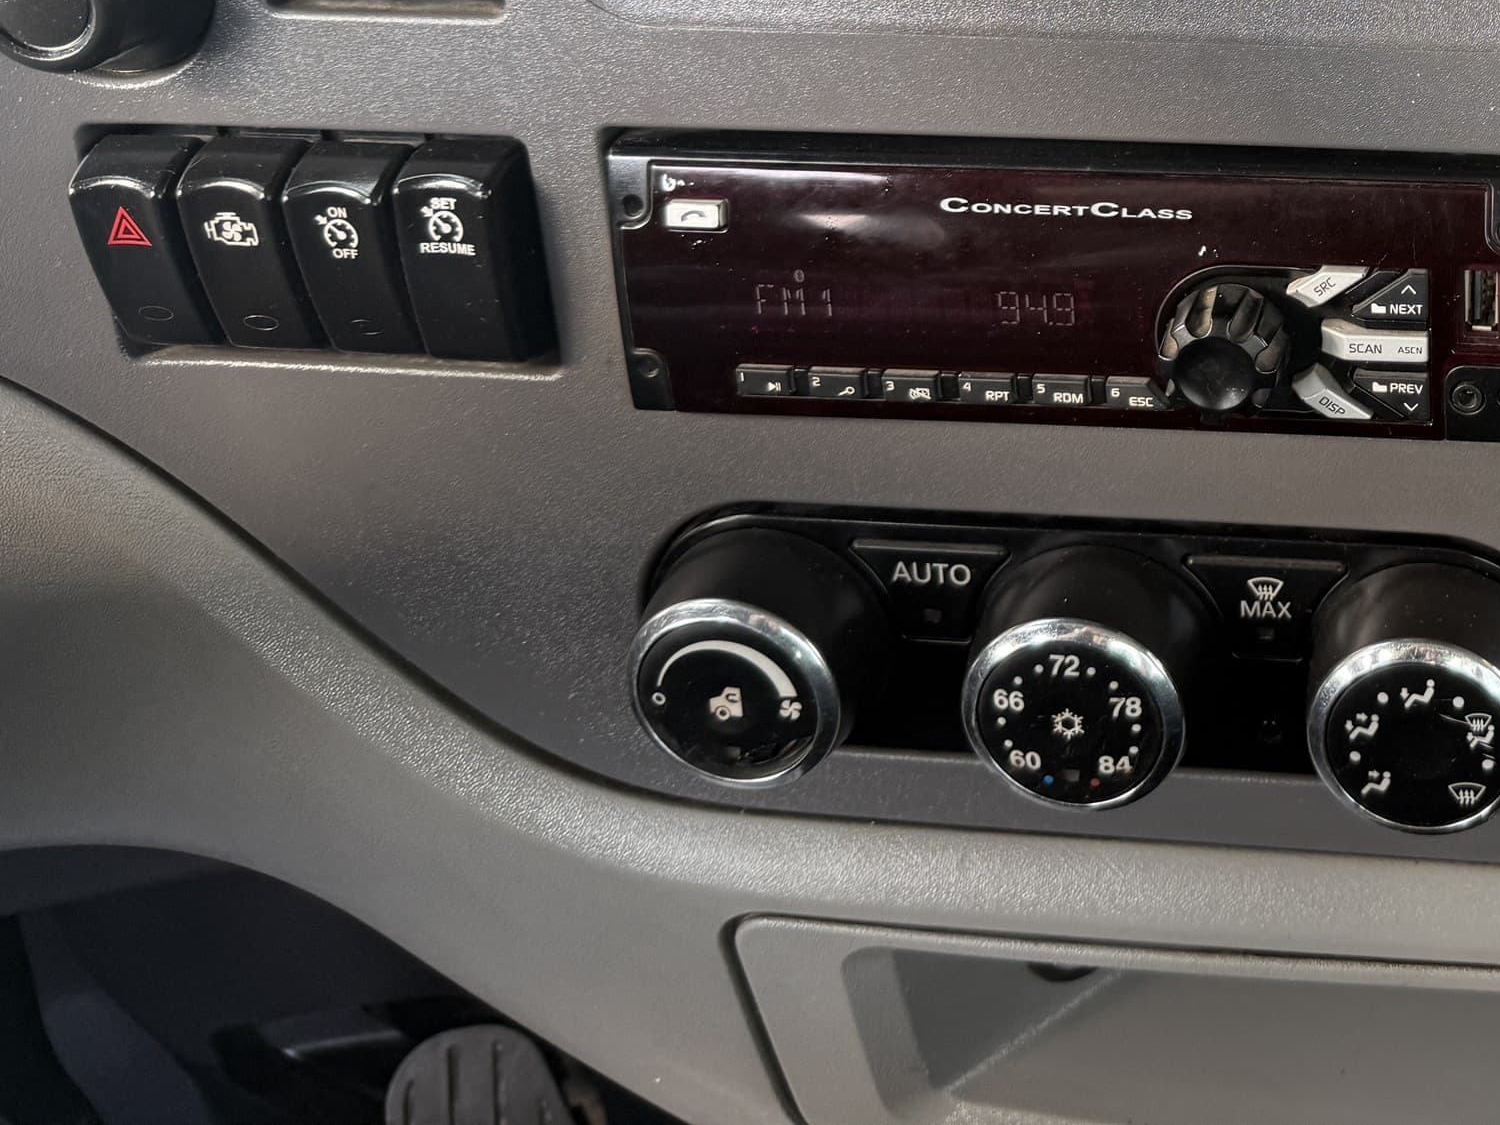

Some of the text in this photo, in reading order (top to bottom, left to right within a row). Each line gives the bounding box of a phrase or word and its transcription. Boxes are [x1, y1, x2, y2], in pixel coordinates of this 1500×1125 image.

[326, 206, 347, 219] ON
[430, 197, 458, 210] SET
[332, 248, 359, 260] OFF
[419, 242, 476, 256] RESUME
[1313, 277, 1337, 297] SRC
[1389, 304, 1423, 315] NEXT
[1348, 343, 1423, 355] SCAN ASCN
[812, 376, 821, 386] 2
[886, 380, 895, 391] 3
[1390, 382, 1423, 395] PREV
[963, 381, 1010, 402] 4 RPT
[1036, 383, 1084, 404] 5 RDM
[1111, 388, 1154, 408] 6 ESC
[1318, 396, 1346, 415] DISP
[892, 561, 972, 586] AUTO
[1240, 600, 1292, 619] MAX
[1048, 654, 1080, 677] 72
[993, 688, 1025, 712] 66
[1108, 697, 1143, 718] 78
[1009, 749, 1042, 771] 60
[1098, 755, 1133, 775] 84
